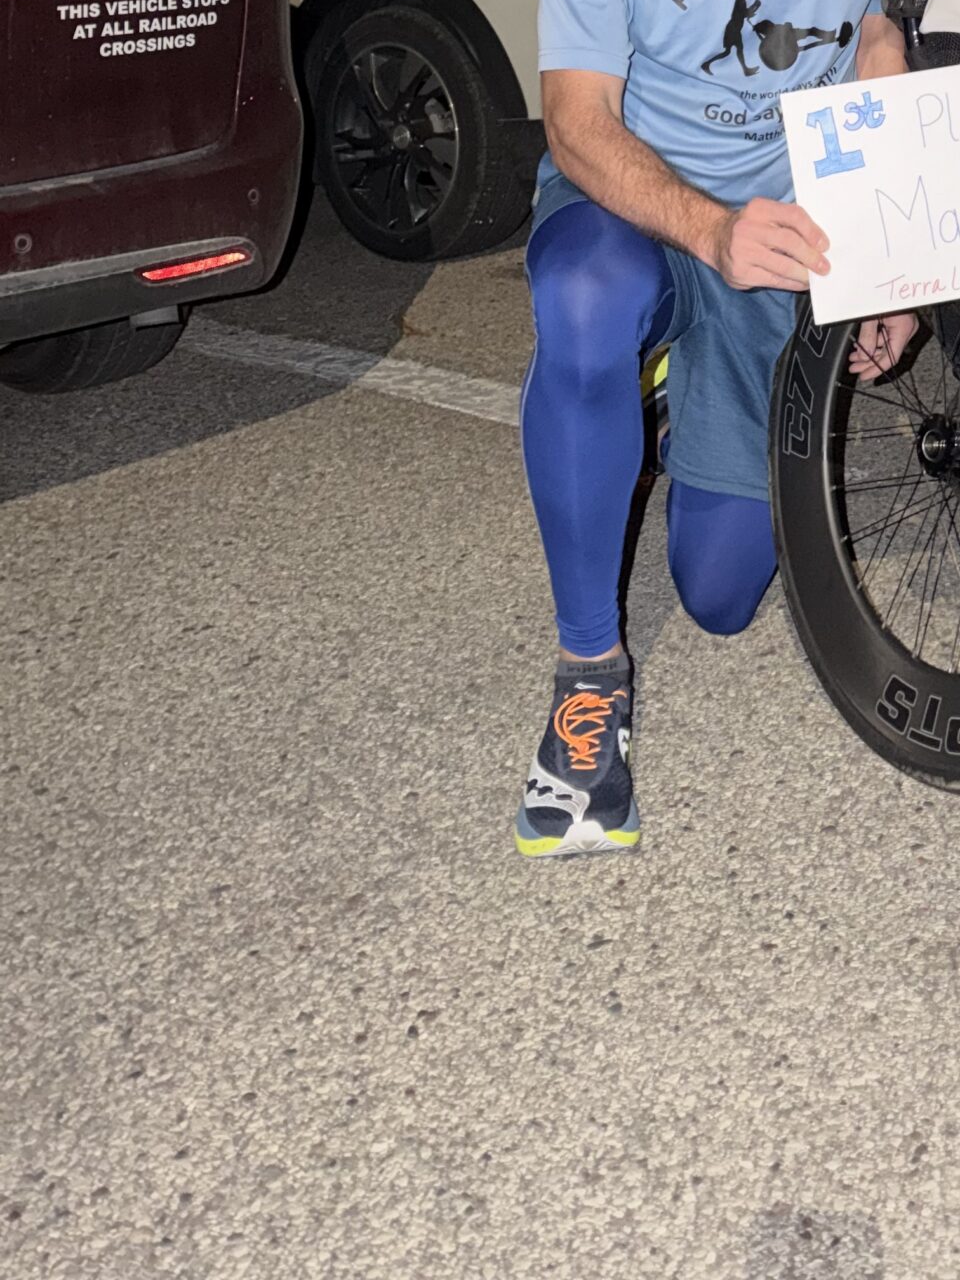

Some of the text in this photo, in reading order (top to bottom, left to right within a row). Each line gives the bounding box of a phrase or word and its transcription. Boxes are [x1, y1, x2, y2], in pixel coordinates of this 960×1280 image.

[57, 3, 101, 20] THIS
[73, 11, 218, 40] AT ALL RAILROAD
[100, 33, 196, 57] CROSSINGS
[740, 90, 757, 100] the
[704, 103, 748, 126] God
[806, 91, 886, 179] 1st
